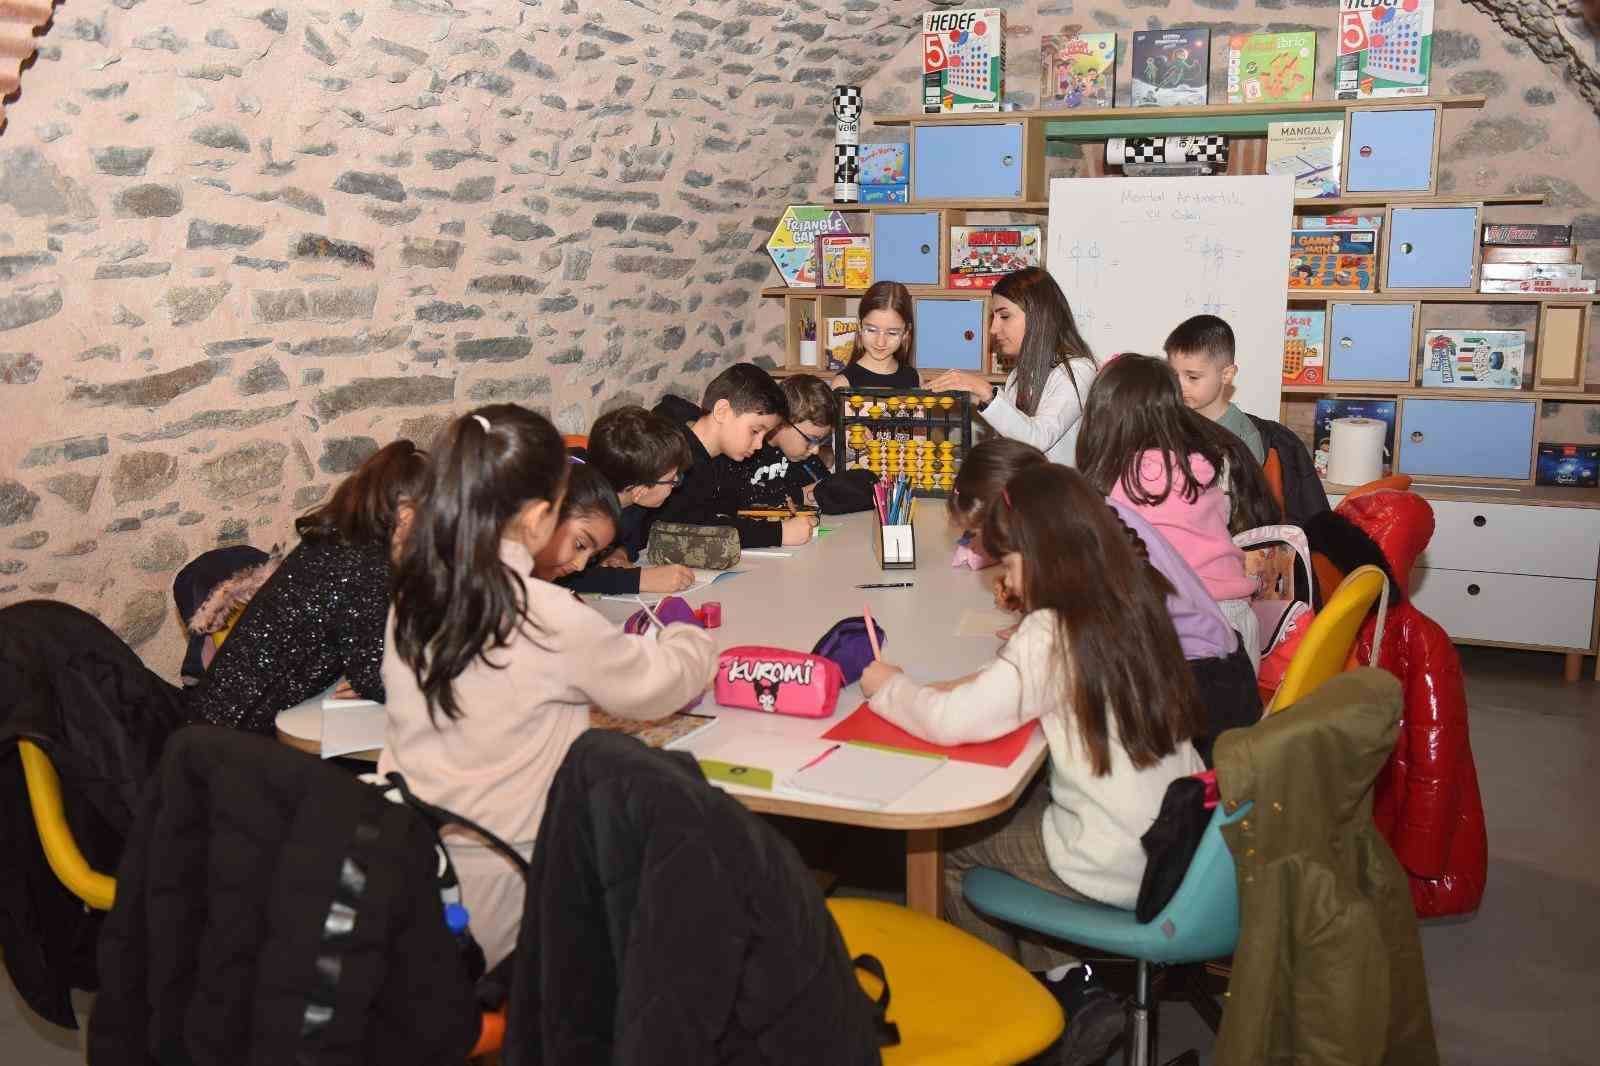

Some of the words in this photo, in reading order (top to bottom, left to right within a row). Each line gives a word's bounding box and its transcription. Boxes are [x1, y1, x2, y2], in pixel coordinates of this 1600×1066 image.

[929, 12, 976, 32] HEDEF
[1343, 13, 1364, 49] 5
[926, 35, 945, 67] 5
[838, 121, 858, 132] vale
[1280, 125, 1332, 138] MANGALA
[784, 215, 843, 232] TRIANGLE
